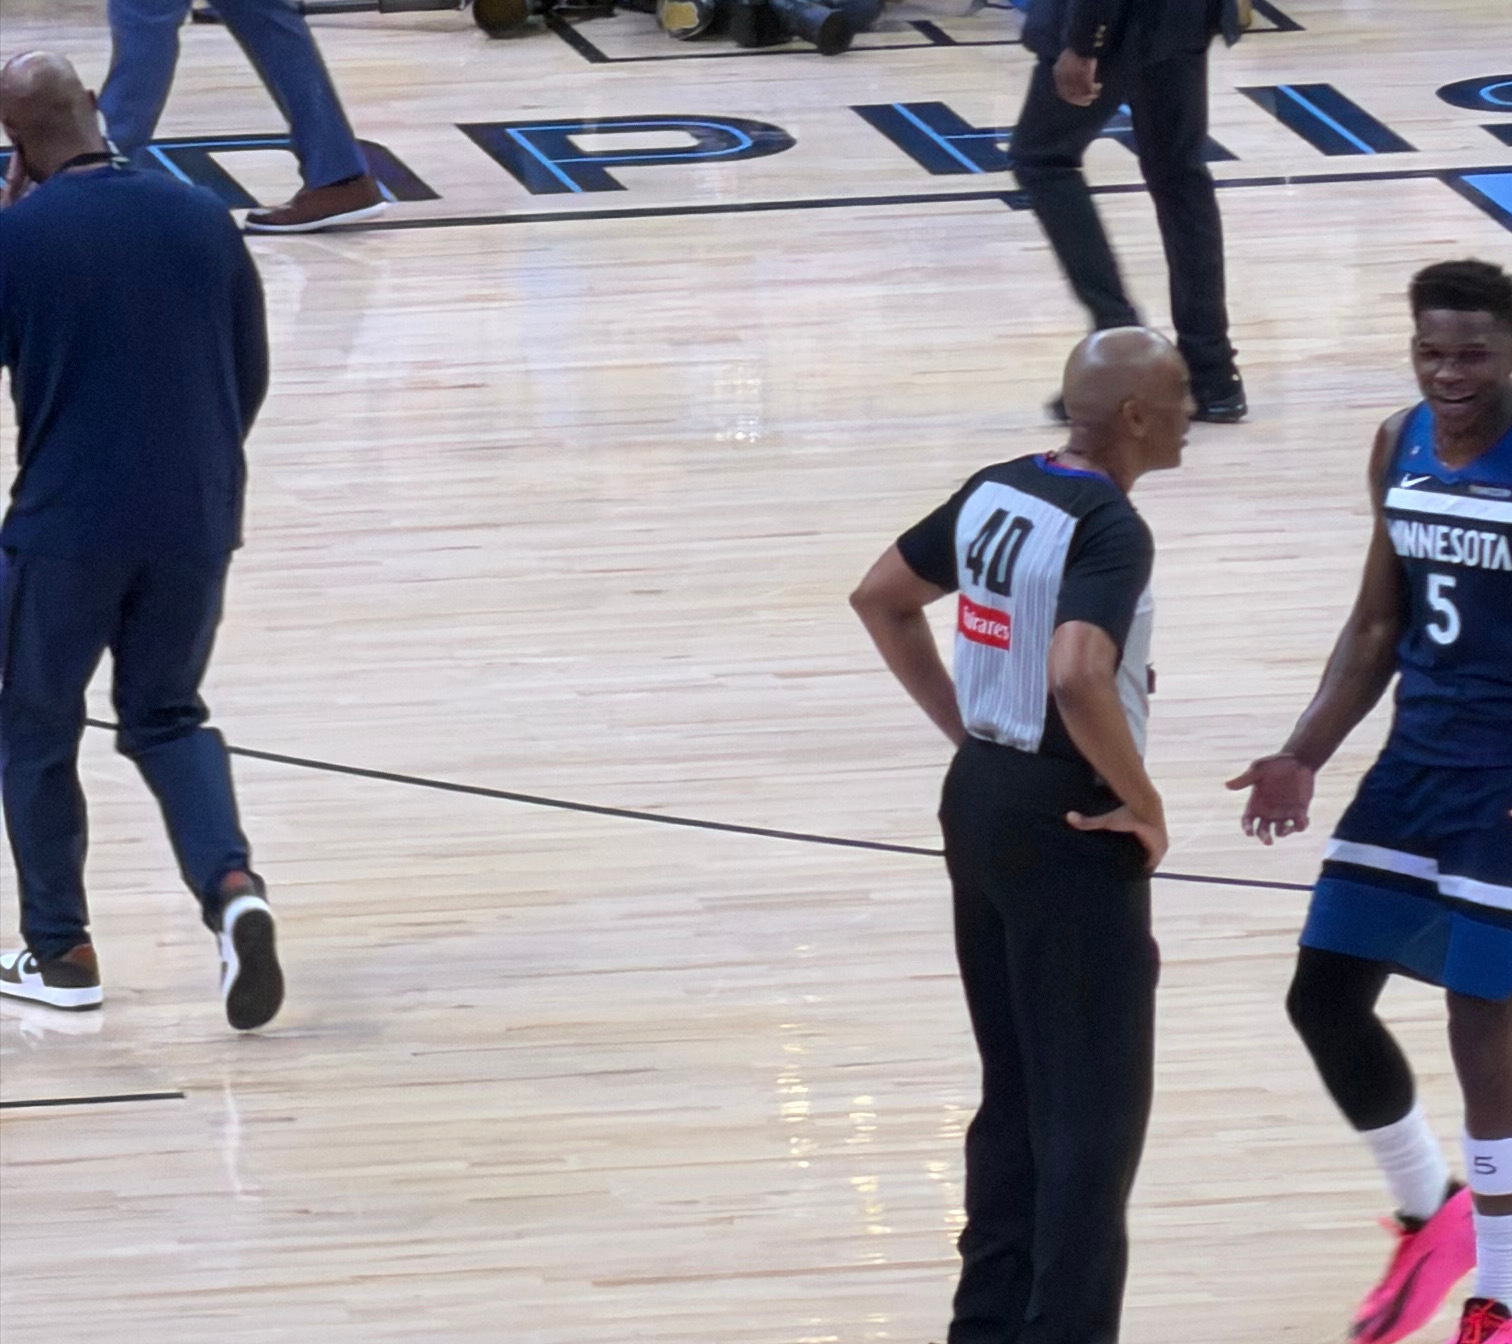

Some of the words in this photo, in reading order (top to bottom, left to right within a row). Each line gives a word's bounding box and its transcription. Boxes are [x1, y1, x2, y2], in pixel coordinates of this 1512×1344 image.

[966, 507, 1035, 598] 40
[1426, 573, 1461, 645] 5
[1473, 1155, 1496, 1175] 5
